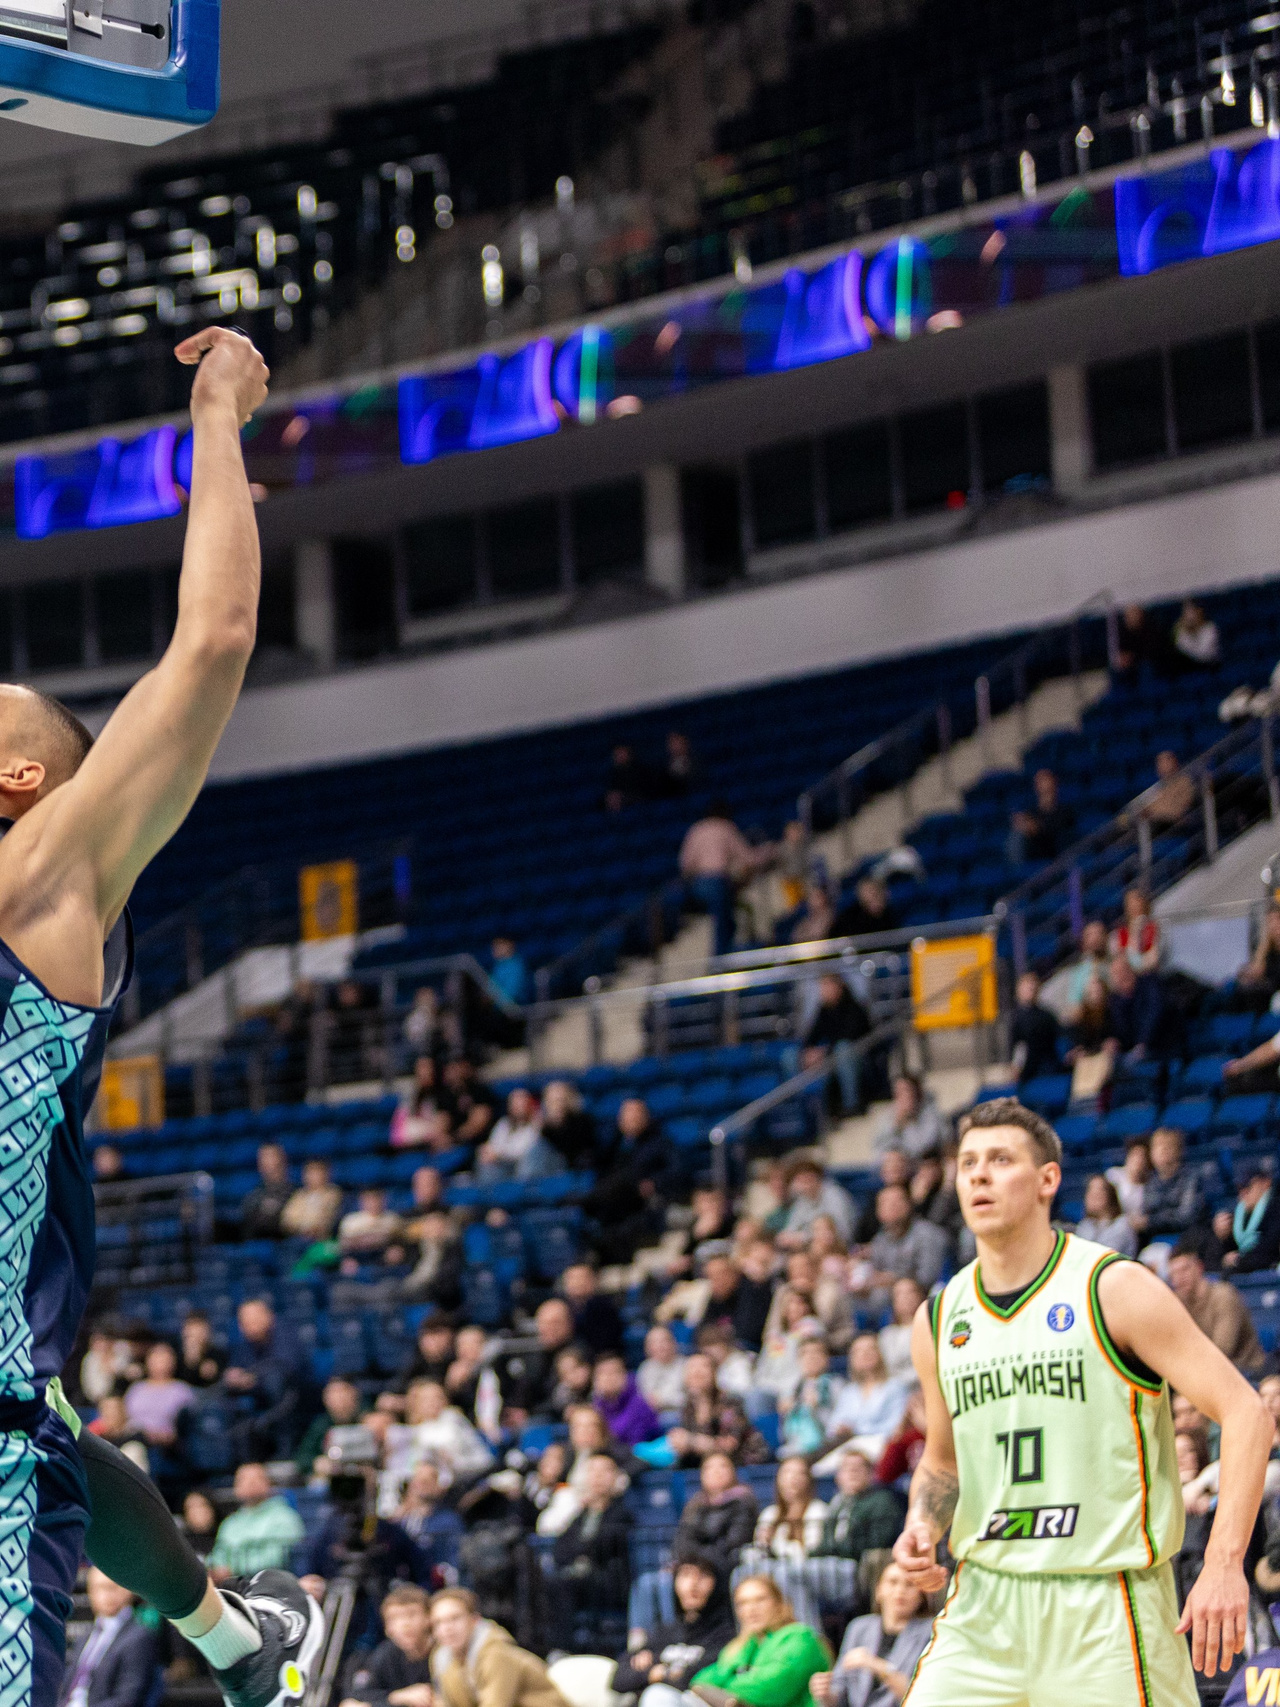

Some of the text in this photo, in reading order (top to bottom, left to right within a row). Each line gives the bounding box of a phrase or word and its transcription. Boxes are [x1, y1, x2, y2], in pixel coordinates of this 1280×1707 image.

[1032, 1348, 1084, 1360] REGION
[946, 1359, 1087, 1419] URALMASH
[995, 1426, 1044, 1486] 10
